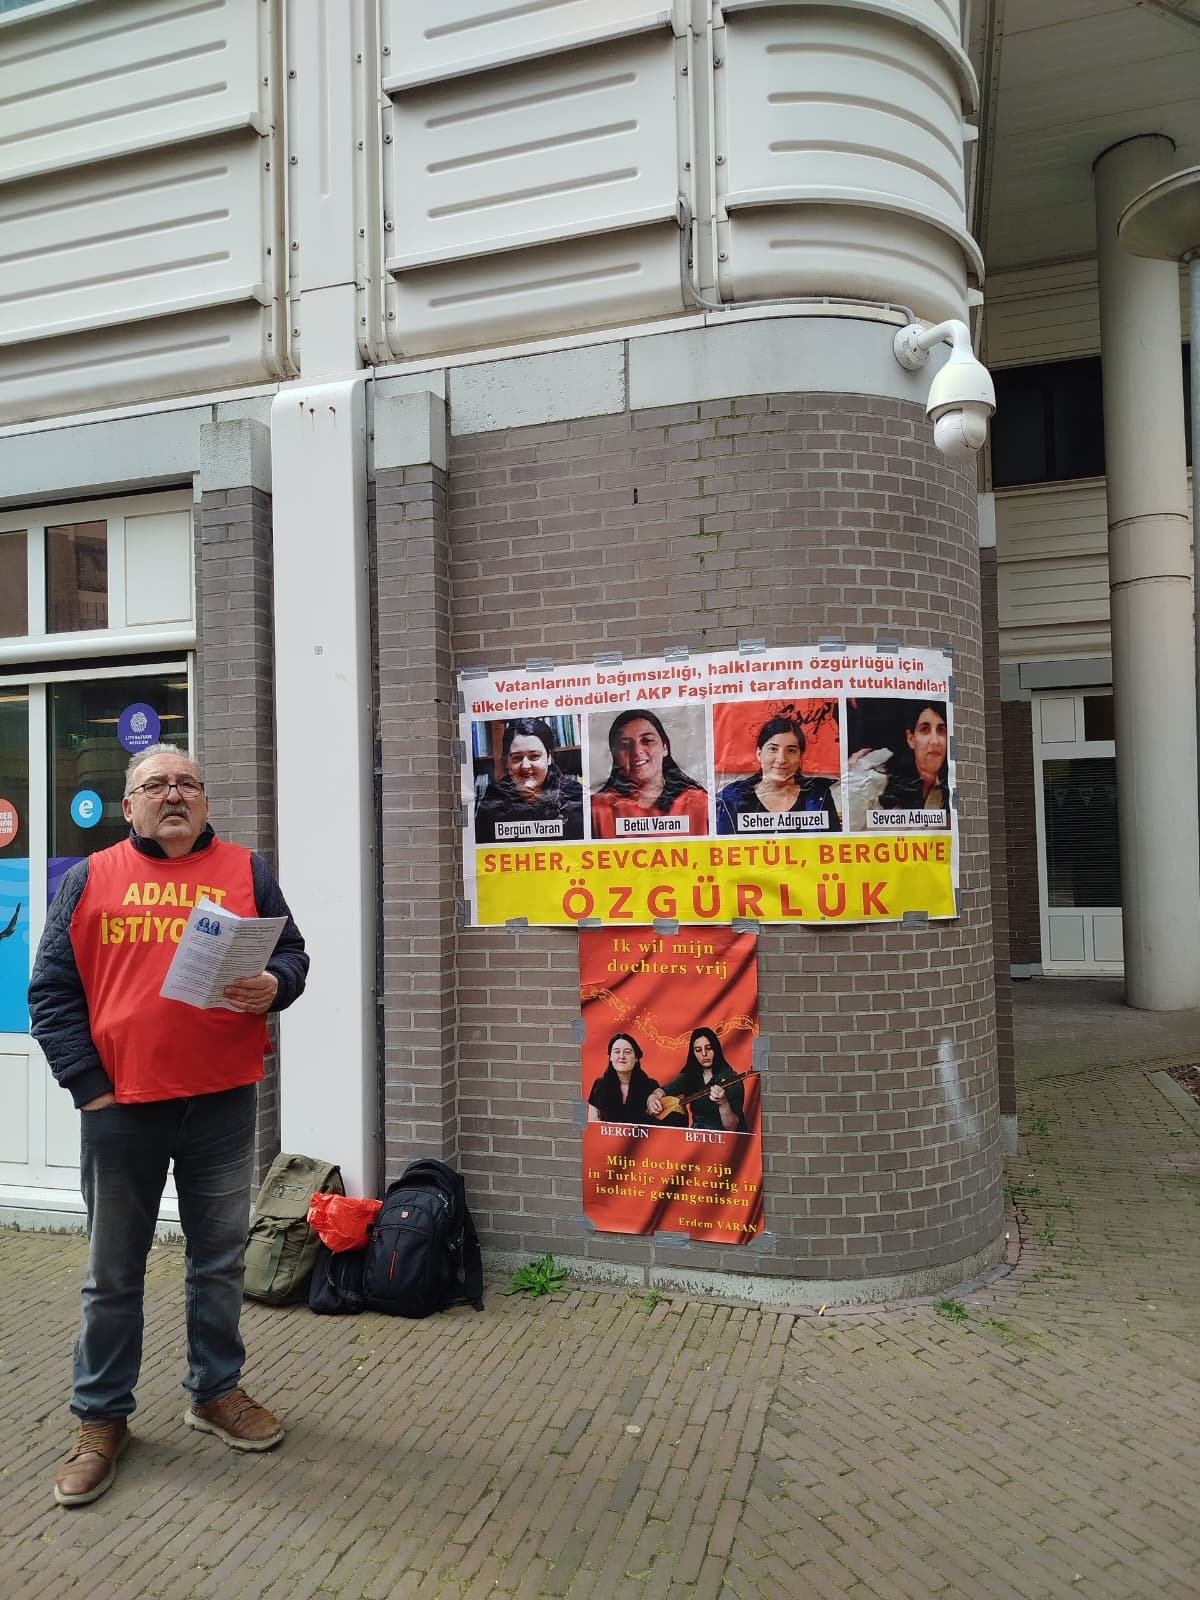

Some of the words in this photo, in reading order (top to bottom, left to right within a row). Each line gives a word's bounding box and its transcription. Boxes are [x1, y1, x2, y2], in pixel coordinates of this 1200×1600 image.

[494, 675, 591, 693] Vatanlarının
[596, 665, 702, 689] bağımsızlığı,
[708, 658, 804, 676] halklarının
[809, 656, 894, 674] özgürlüğü
[899, 656, 924, 674] için
[472, 695, 549, 713] ülkelerine
[554, 689, 631, 708] döndüler!
[636, 686, 672, 701] AKP
[678, 680, 744, 699] Faşizmi
[749, 677, 844, 694] tarafından
[849, 675, 947, 693] tutuklandılar!
[497, 822, 531, 838] Bergün
[534, 821, 561, 835] Varan
[623, 818, 650, 832] Betül
[652, 818, 681, 831] Varan
[742, 814, 774, 828] Seher
[872, 811, 906, 826] Sevcan
[484, 852, 571, 873] SEHER,
[581, 848, 698, 870] SEVCAN,
[709, 840, 807, 868] BETÜL,
[819, 837, 945, 864] BERGÜN'E
[562, 872, 890, 920] ÖZGÜRLÜK
[101, 910, 188, 945] İSTİYO
[613, 938, 631, 953] Ik
[638, 939, 664, 953] wil
[672, 940, 715, 959] mijn
[607, 959, 688, 975] dochters
[695, 961, 728, 980] vrij
[607, 1155, 636, 1170] Mijn
[641, 1157, 701, 1172] dochters
[706, 1163, 732, 1177] zijn
[588, 1168, 601, 1179] in
[605, 1169, 656, 1186] Turkije
[660, 1175, 737, 1193] willekeurig
[744, 1180, 758, 1192] in
[595, 1183, 645, 1197] isolatie
[650, 1190, 750, 1207] gevangenissen
[679, 1217, 713, 1229] Erdem
[717, 1222, 757, 1233] VARAN
